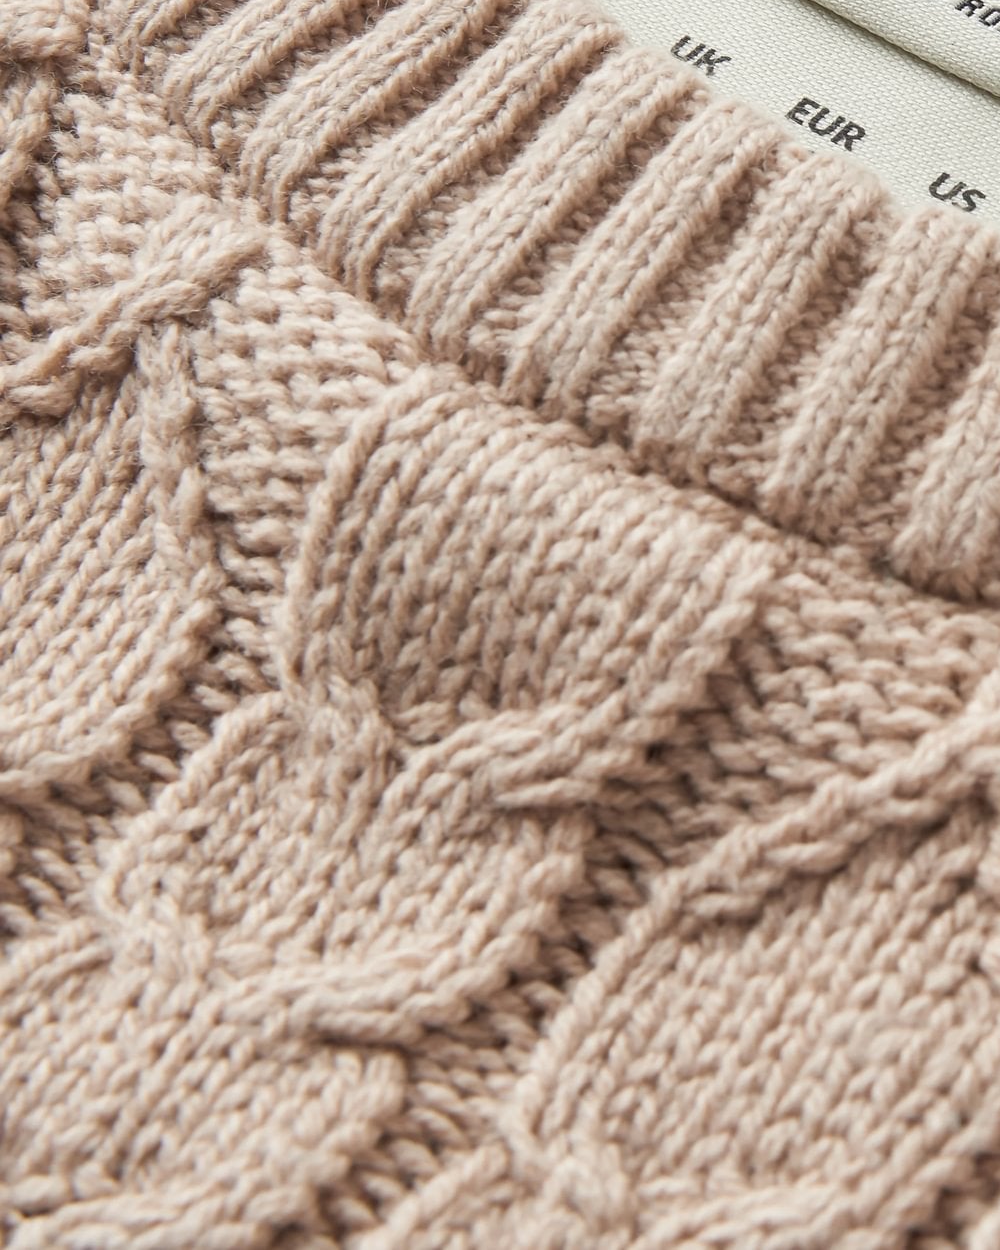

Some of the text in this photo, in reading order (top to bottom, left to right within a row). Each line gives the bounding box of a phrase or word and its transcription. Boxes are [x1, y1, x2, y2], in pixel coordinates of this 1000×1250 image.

[670, 35, 986, 213] UK EUR US
